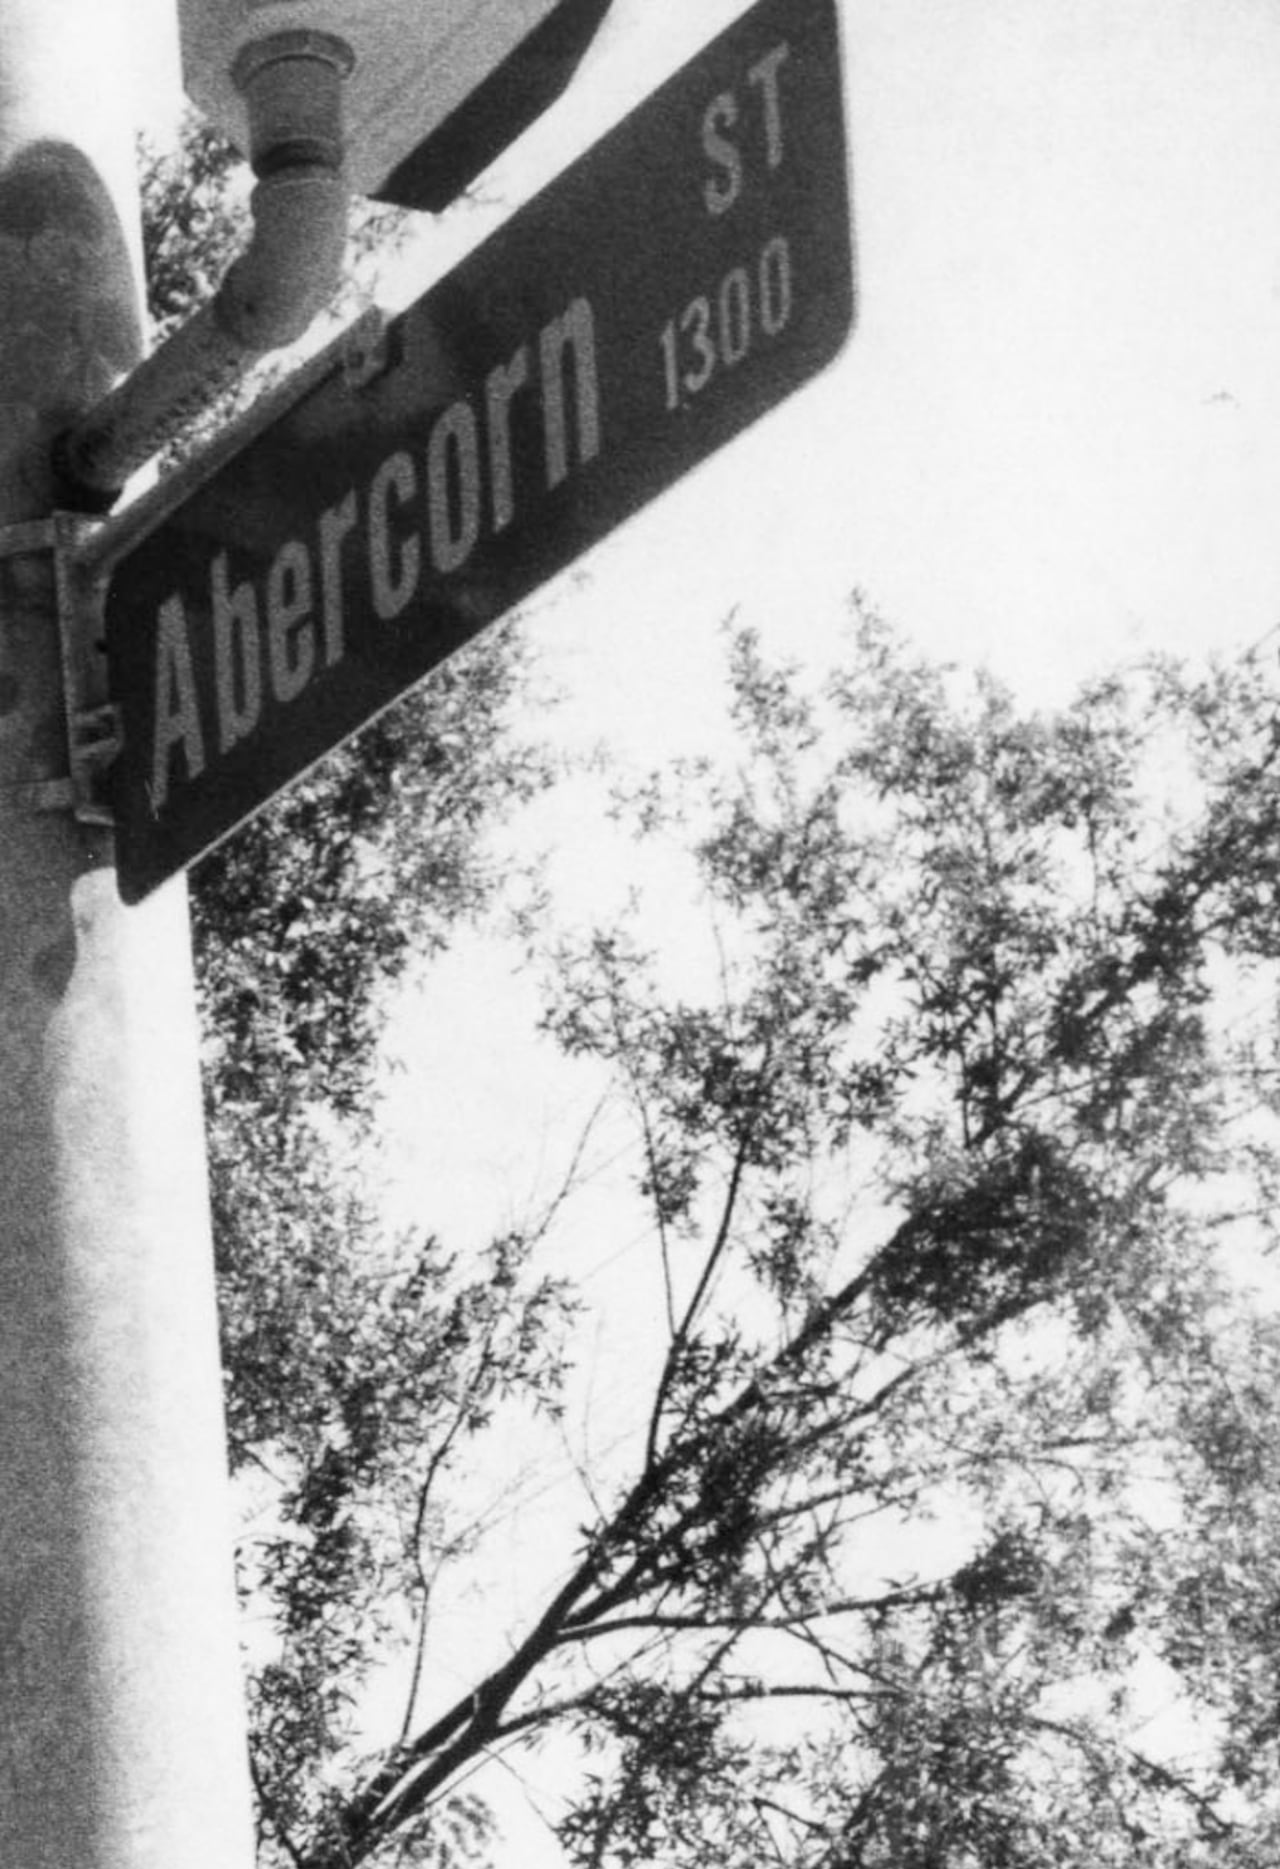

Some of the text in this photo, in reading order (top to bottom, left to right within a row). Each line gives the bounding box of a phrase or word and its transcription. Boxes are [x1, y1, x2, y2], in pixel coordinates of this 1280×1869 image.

[702, 43, 789, 215] ST
[659, 237, 792, 411] 1300
[150, 297, 600, 807] Abercorn
